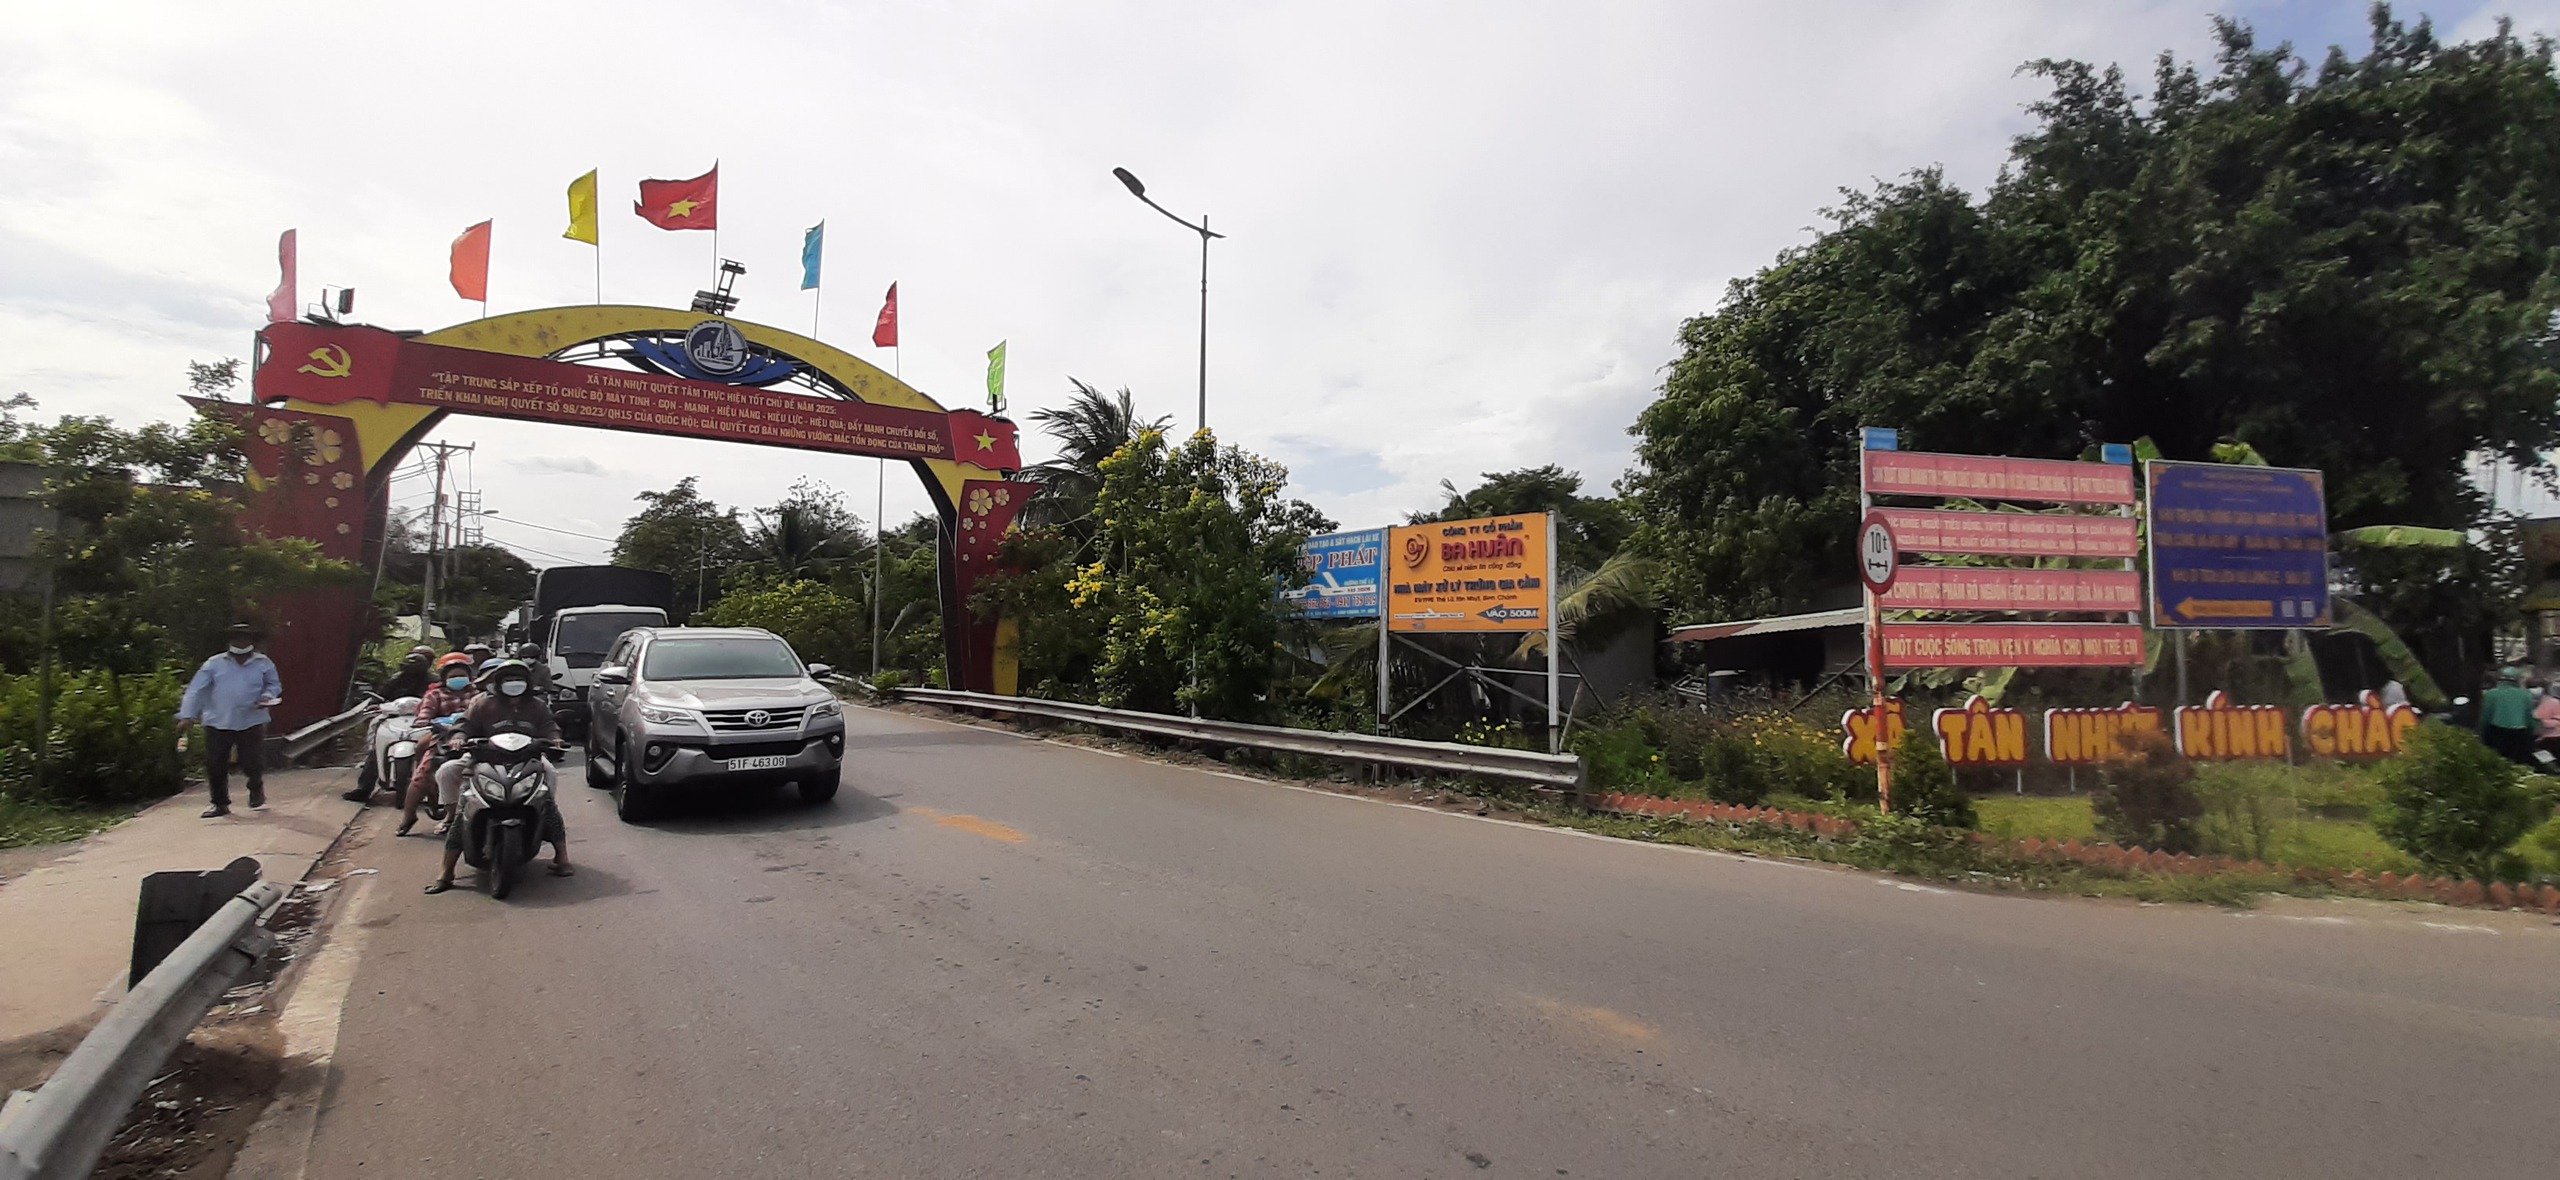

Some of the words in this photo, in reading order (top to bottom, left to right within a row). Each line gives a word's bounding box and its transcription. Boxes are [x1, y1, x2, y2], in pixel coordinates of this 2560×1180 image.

[587, 373, 600, 385] XÃ
[603, 375, 622, 389] TÂN
[623, 377, 647, 392] NHỰT
[650, 380, 679, 395] QUYẾT
[682, 385, 701, 398] TÂM
[702, 388, 725, 402] THỰC
[727, 391, 747, 405] HIỆN
[749, 393, 765, 406] TỐT
[766, 395, 782, 409] CHỦ
[784, 398, 795, 410] ĐỀ
[797, 400, 814, 413] NĂM
[1328, 543, 1378, 569] PHÁT
[1486, 608, 1507, 618] VÀO
[1510, 609, 1537, 618] 500M
[1934, 695, 2027, 764] TÂN
[2175, 690, 2285, 759] KÍNH
